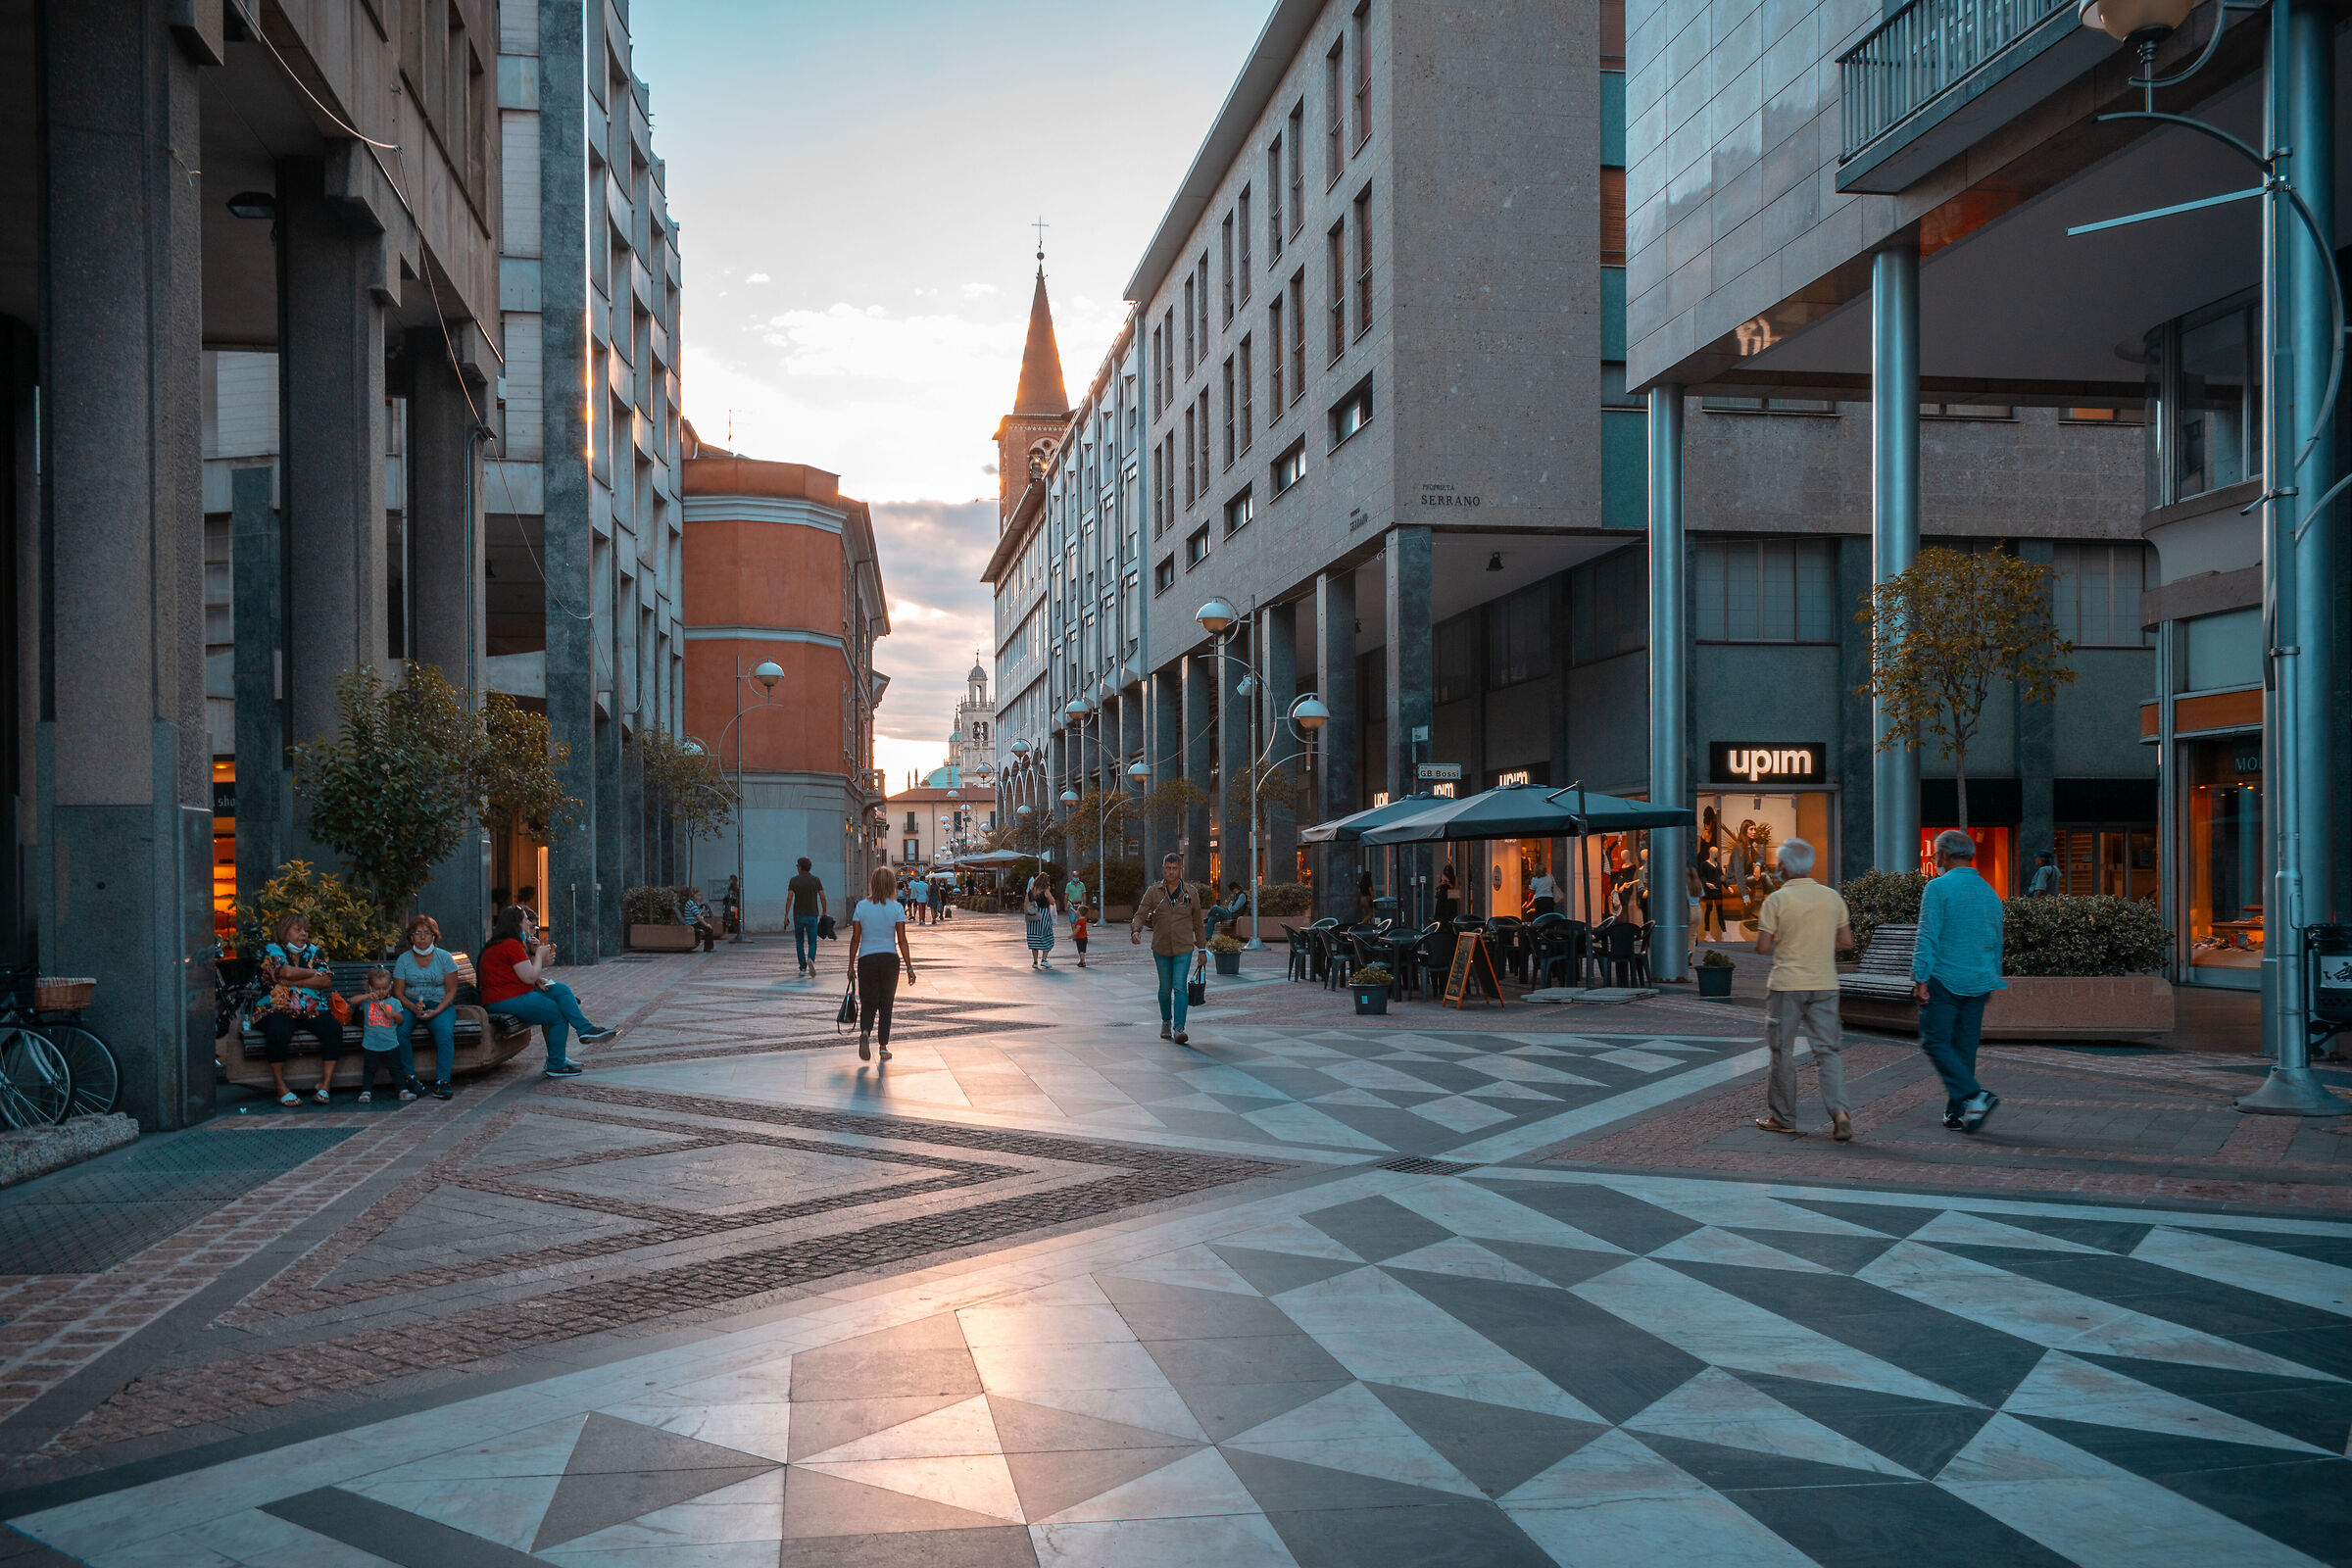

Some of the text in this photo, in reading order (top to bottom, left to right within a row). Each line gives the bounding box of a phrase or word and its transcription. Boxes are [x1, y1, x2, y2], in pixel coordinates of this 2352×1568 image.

[1420, 494, 1481, 507] SERRANO
[1728, 750, 1812, 782] upim
[1436, 769, 1459, 778] Bossi
